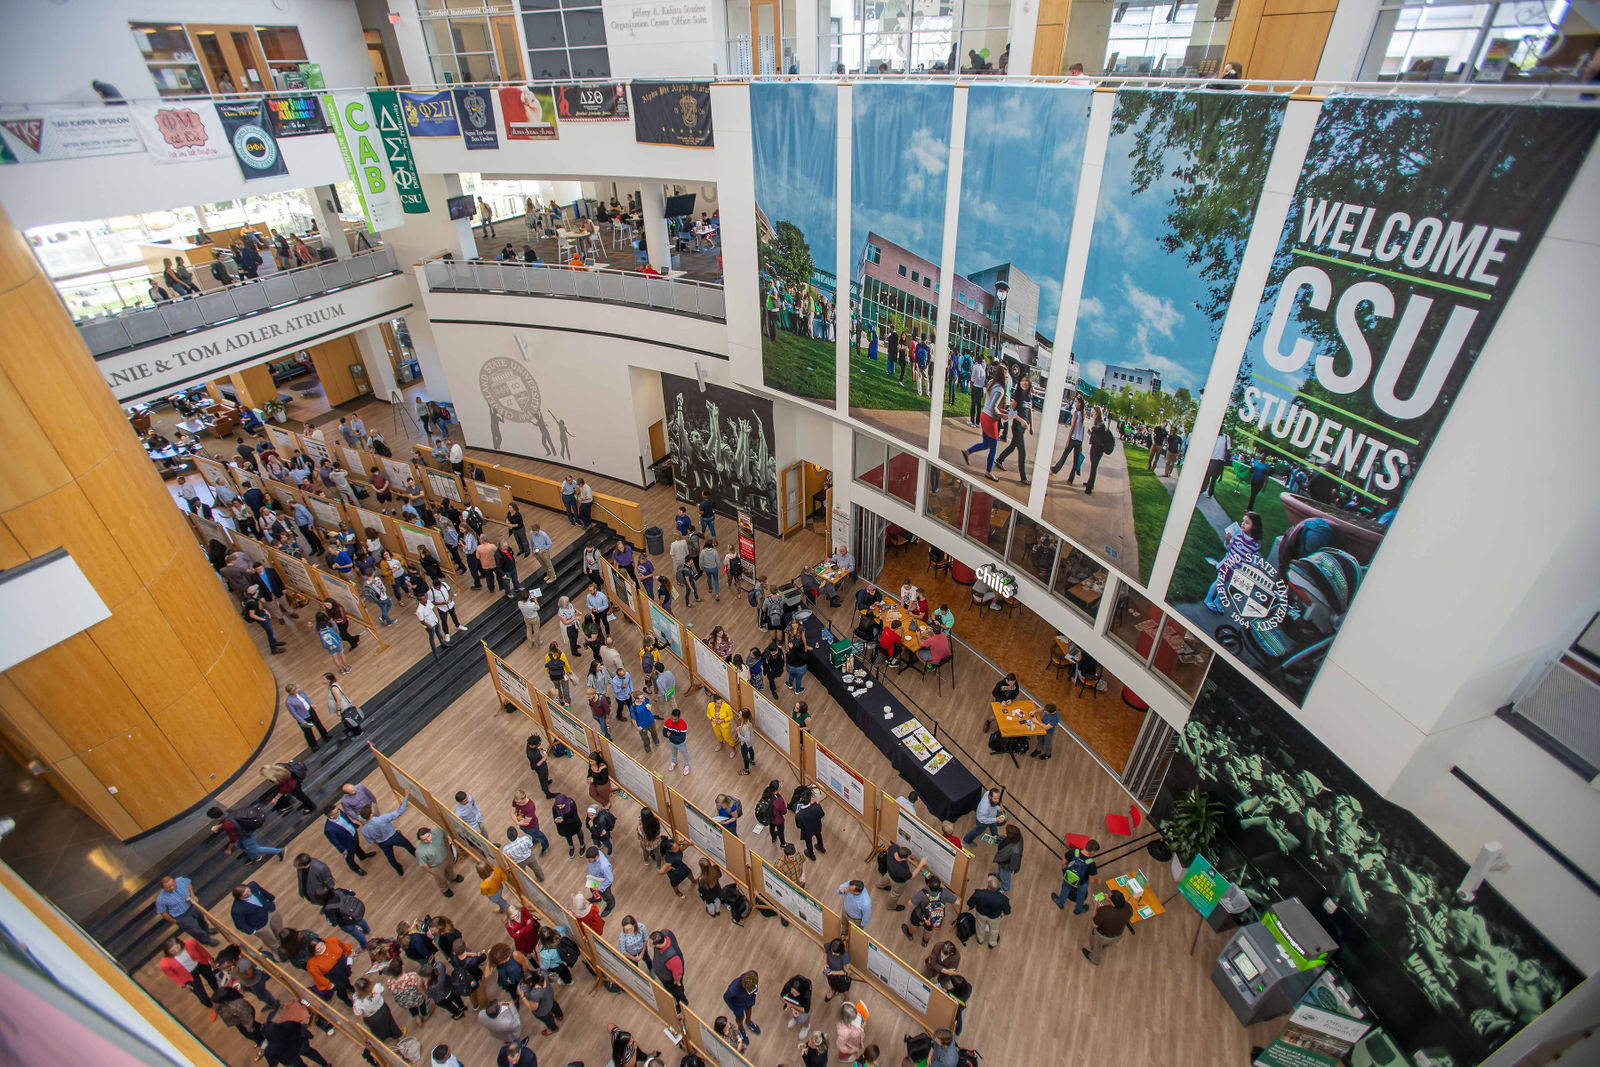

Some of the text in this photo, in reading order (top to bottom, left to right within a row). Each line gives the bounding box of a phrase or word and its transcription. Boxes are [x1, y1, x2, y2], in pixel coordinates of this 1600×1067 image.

[684, 4, 706, 14] Student
[610, 19, 648, 32] Organization
[650, 18, 670, 28] Center
[672, 16, 690, 26] Office
[580, 90, 603, 104] ΔΣΘ
[641, 90, 658, 103] Alpha
[658, 86, 669, 96] Phi
[671, 83, 689, 93] Alpha
[69, 119, 97, 128] KAPPA
[97, 116, 130, 126] EPSILON
[278, 109, 315, 121] Alliance
[392, 103, 406, 137] Fraternity
[338, 136, 354, 175] activities
[345, 102, 386, 194] CAB
[400, 193, 424, 204] CSU
[1300, 197, 1521, 286] WELCOME
[106, 303, 346, 388] NIE & TOM ADLER ATRIUM
[1263, 265, 1479, 420] CSU
[484, 359, 508, 374] STATE
[1238, 386, 1409, 491] STUDENTS
[1216, 552, 1289, 632] CLEVELAND STATE UNIVERSITY
[1231, 611, 1250, 629] 1964
[1189, 877, 1214, 903] CONTEST
[1193, 874, 1215, 897] POSTER
[1199, 874, 1214, 889] BEST
[1276, 919, 1306, 956] Huntington
